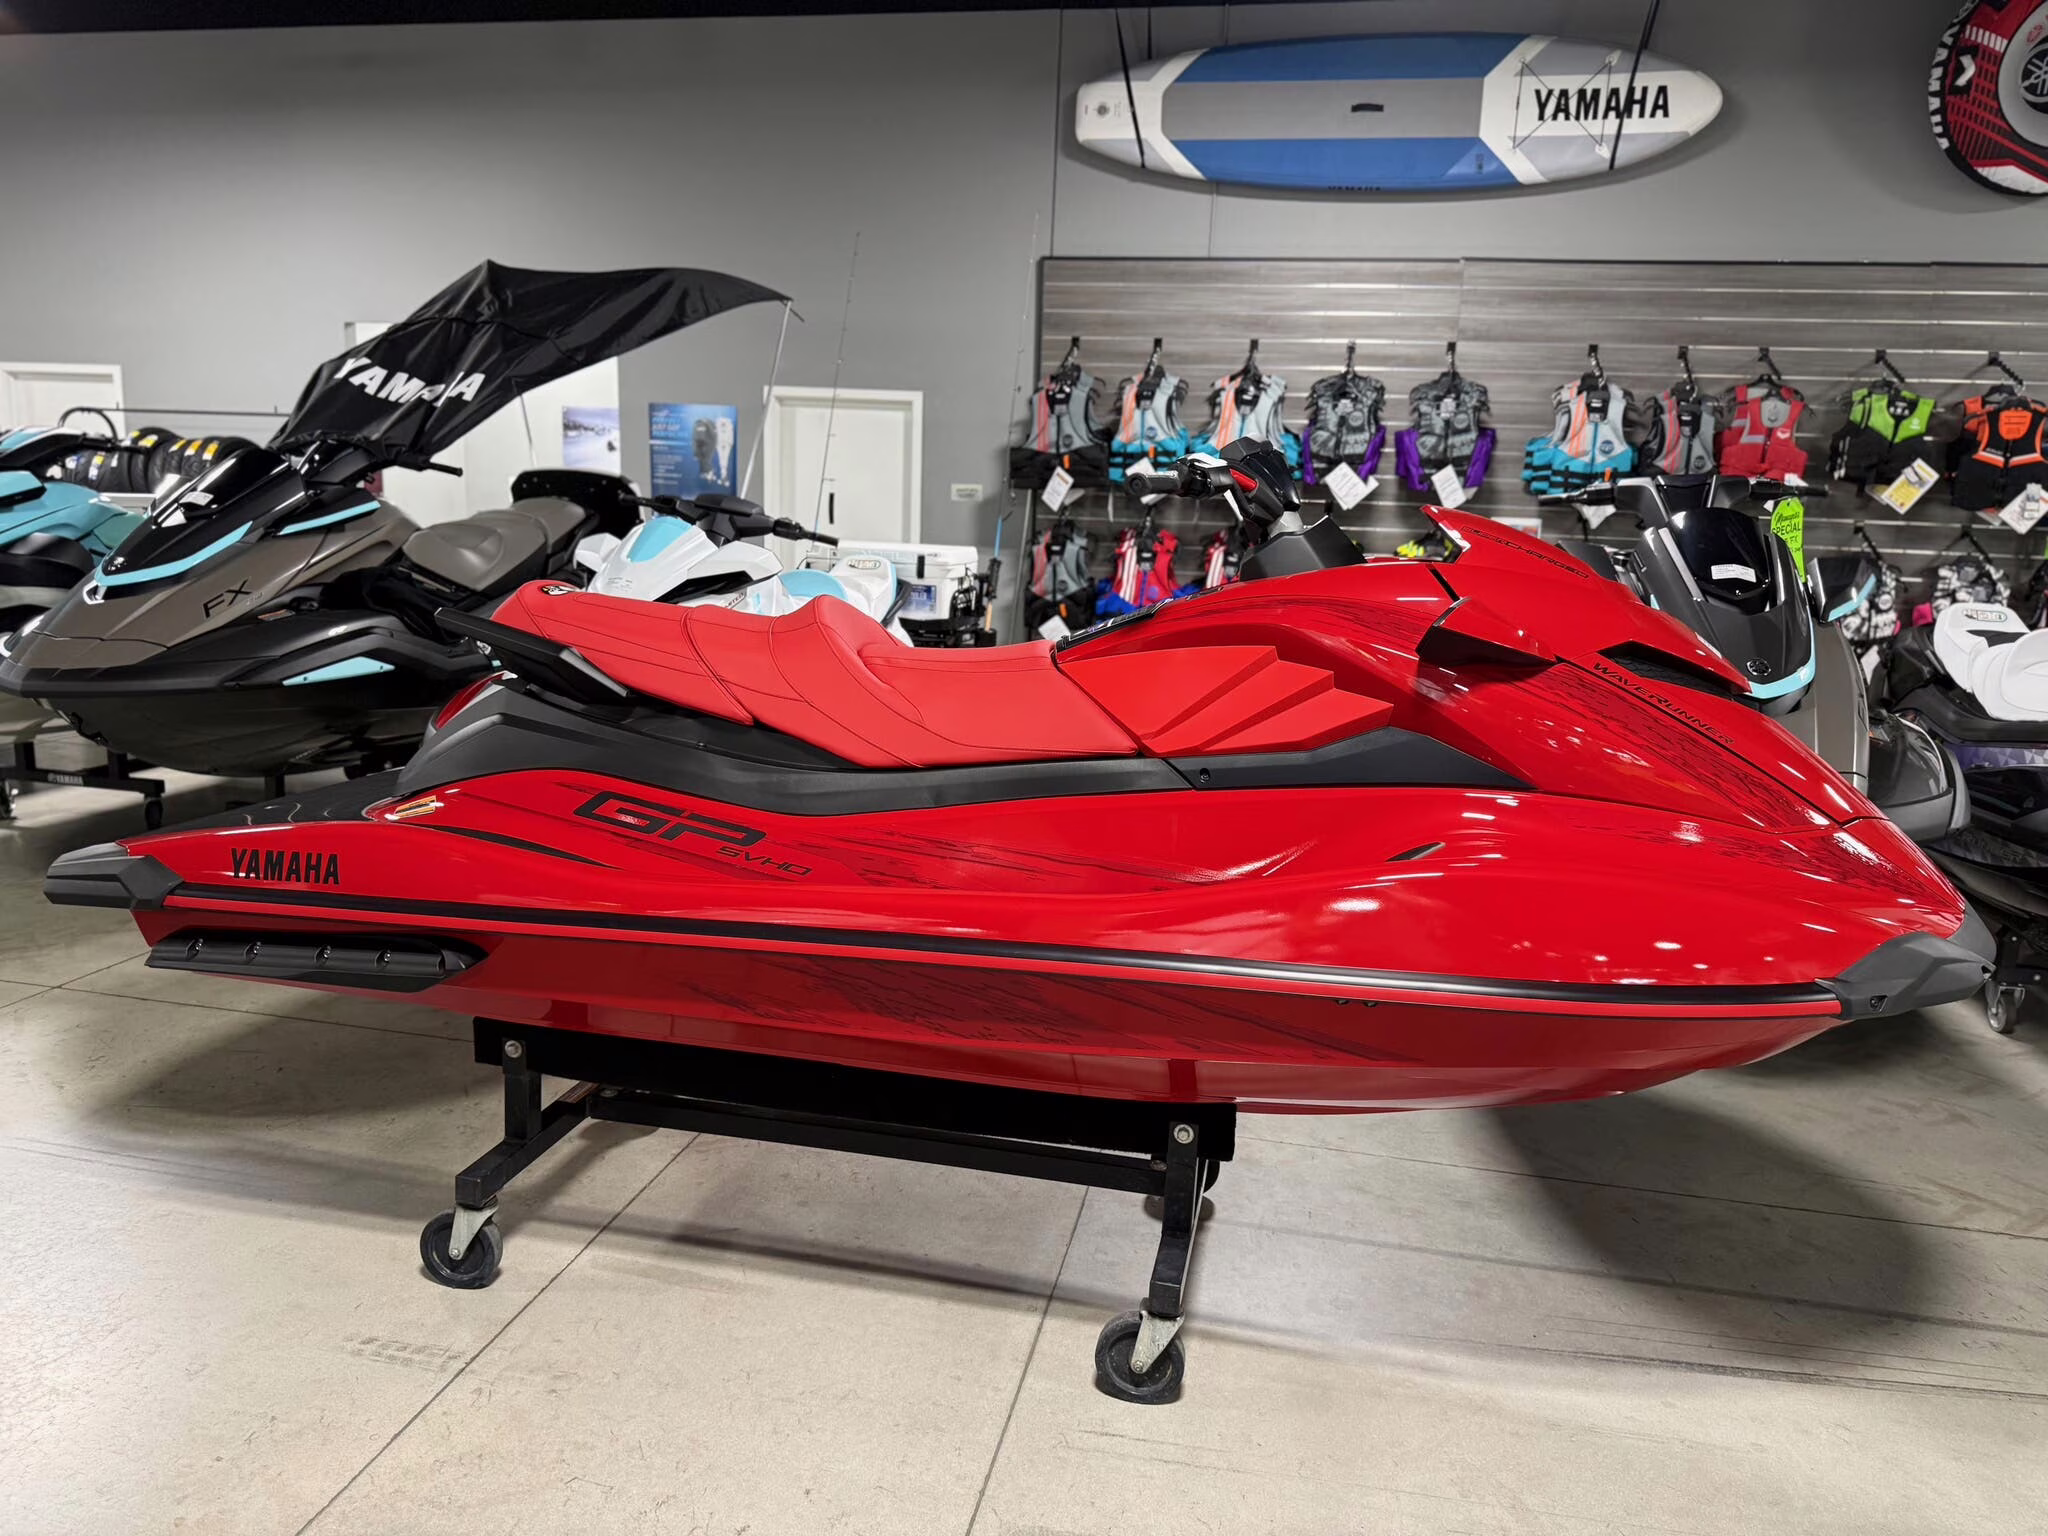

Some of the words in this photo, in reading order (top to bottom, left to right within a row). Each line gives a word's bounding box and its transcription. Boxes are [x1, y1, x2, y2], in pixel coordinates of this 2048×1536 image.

[1534, 85, 1669, 121] YAMAHA
[203, 579, 252, 619] FX
[573, 791, 767, 847] GP
[231, 848, 339, 885] YAMAHA
[717, 846, 812, 876] SVHO
